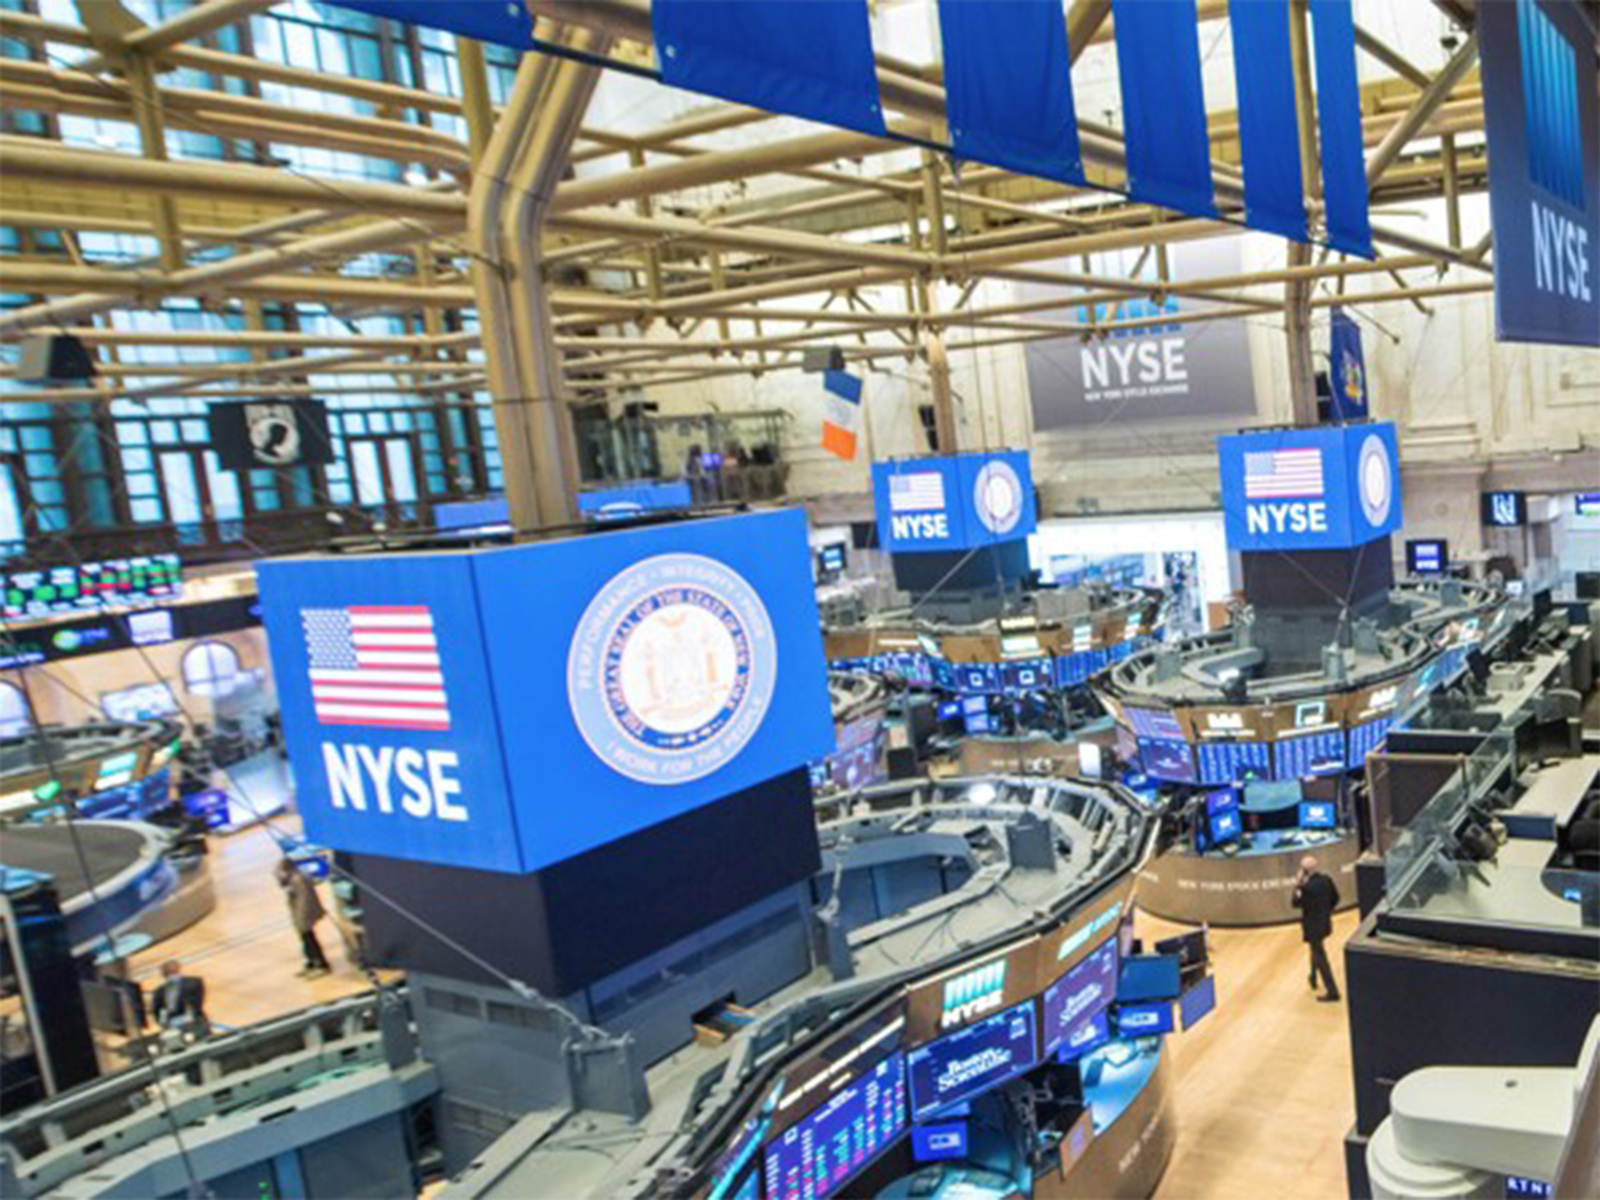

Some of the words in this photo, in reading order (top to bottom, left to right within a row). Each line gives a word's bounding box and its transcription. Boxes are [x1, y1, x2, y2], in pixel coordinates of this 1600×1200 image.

[1531, 201, 1592, 303] NYSE
[1080, 338, 1188, 389] NYSE
[891, 514, 949, 539] NYSE
[1246, 502, 1328, 534] NYSE
[322, 742, 469, 821] NYSE
[942, 990, 1002, 1027] NYSE
